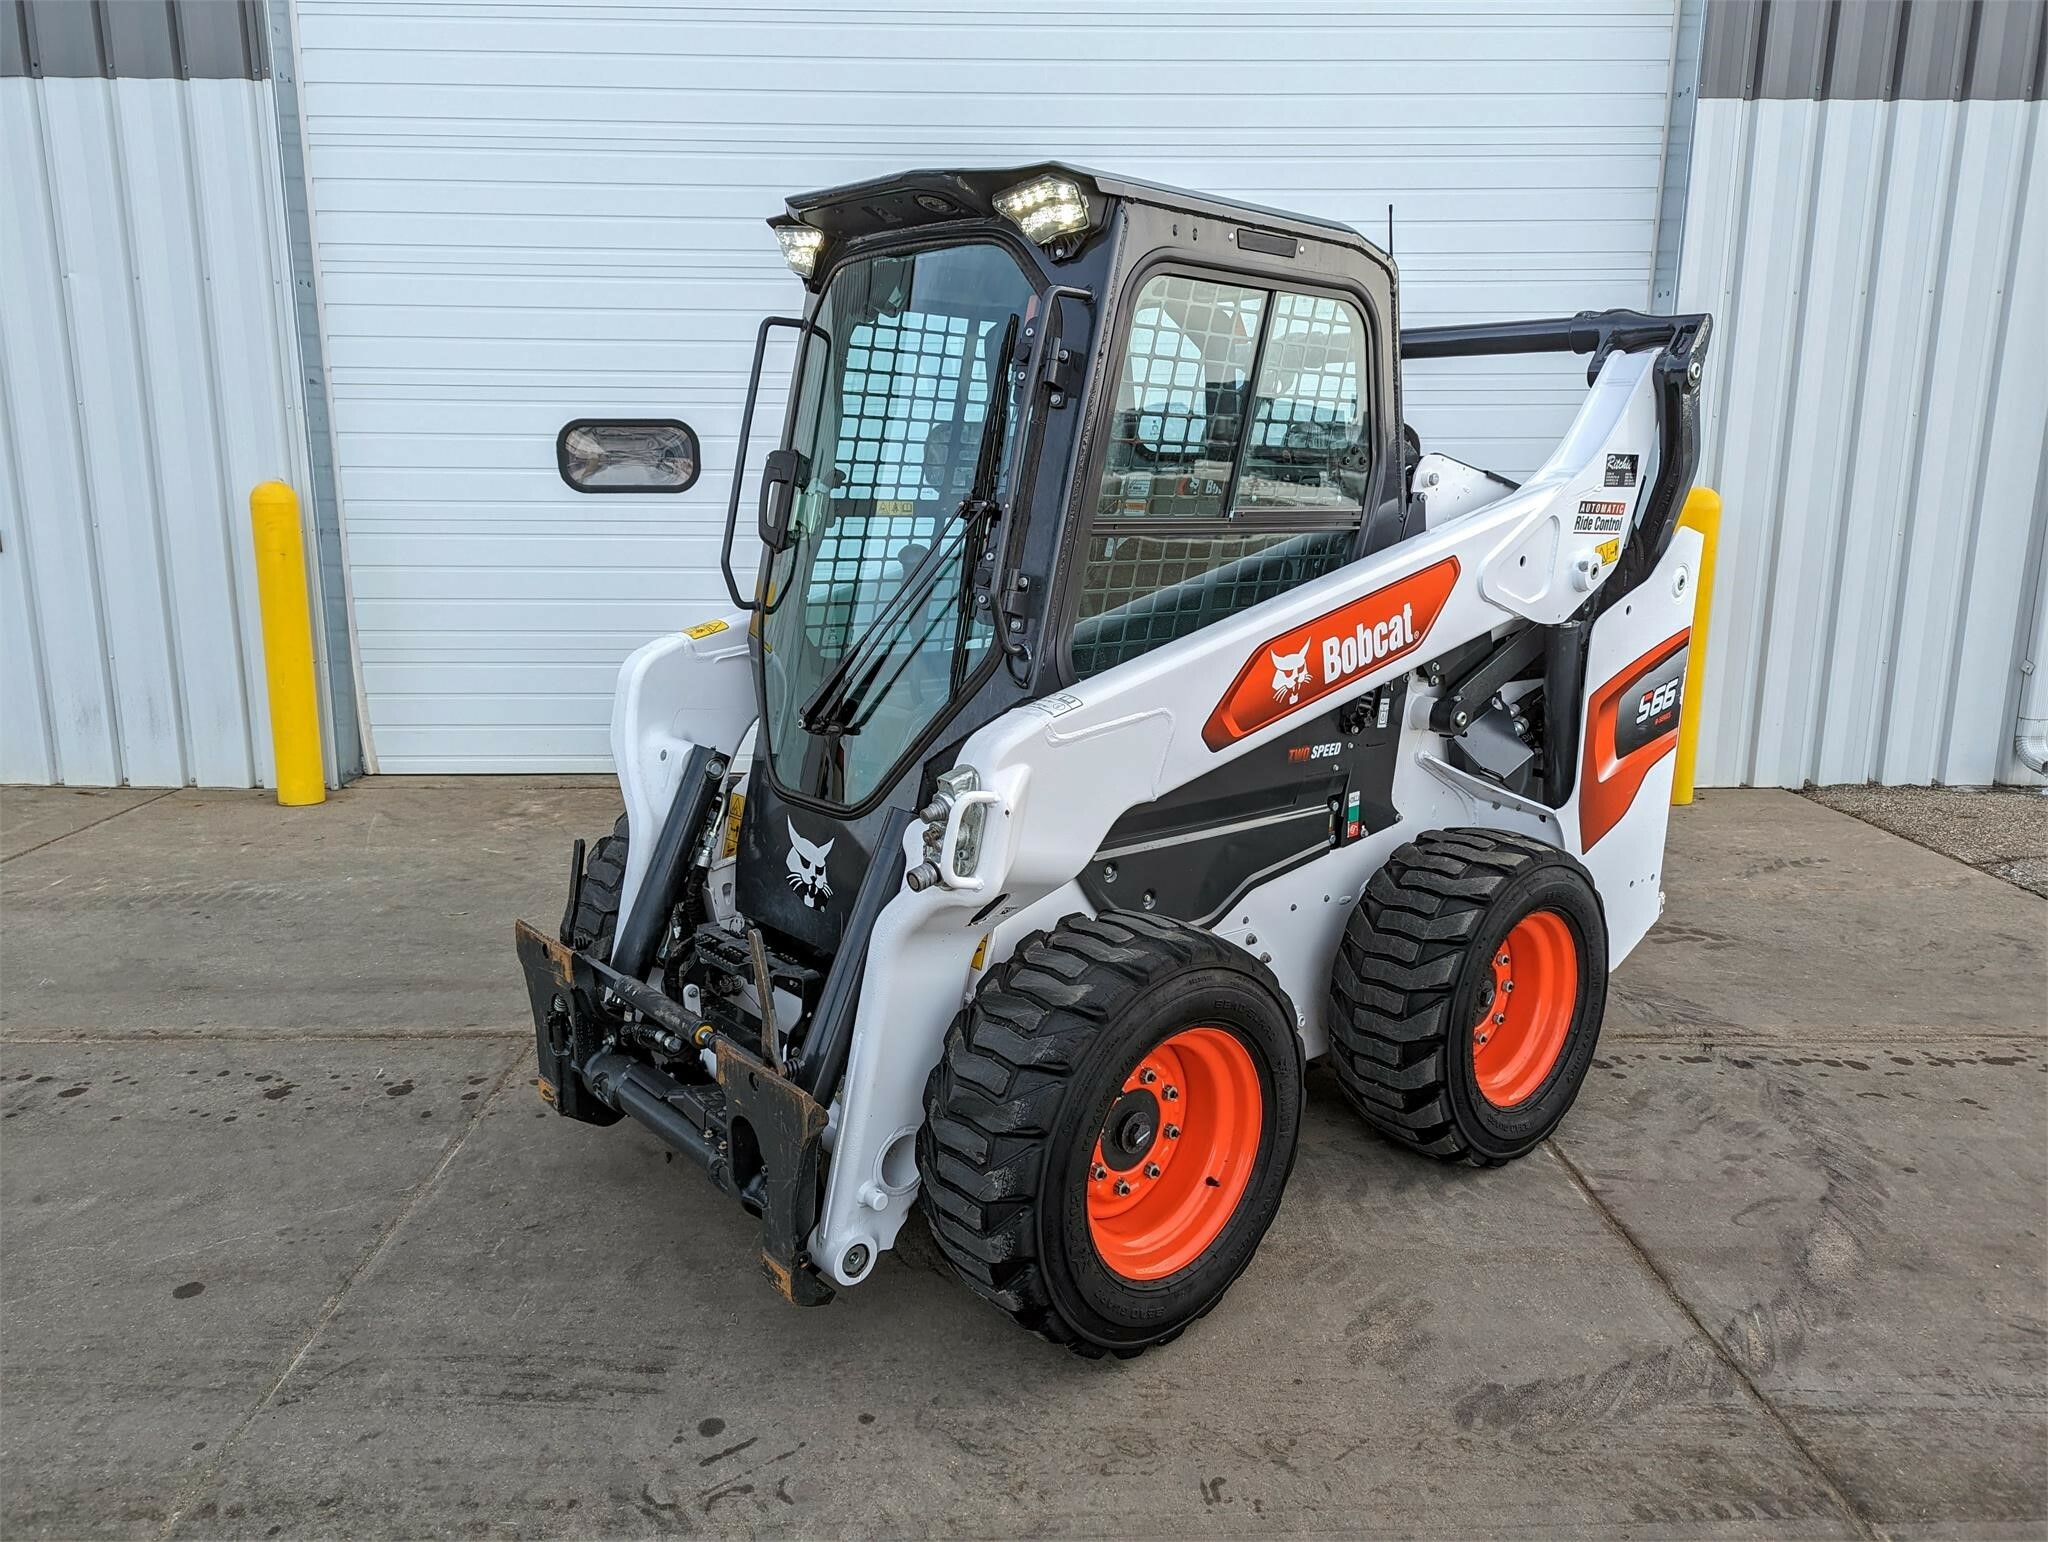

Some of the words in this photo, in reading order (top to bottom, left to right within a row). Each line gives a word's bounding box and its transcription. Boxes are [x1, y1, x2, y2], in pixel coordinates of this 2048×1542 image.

[1579, 502, 1625, 514] AUTOMATIC
[1574, 516, 1594, 531] Ride
[1594, 516, 1623, 531] Control
[1322, 602, 1414, 685] Bobcat
[1636, 677, 1679, 724] S66
[1311, 741, 1342, 759] SPEED
